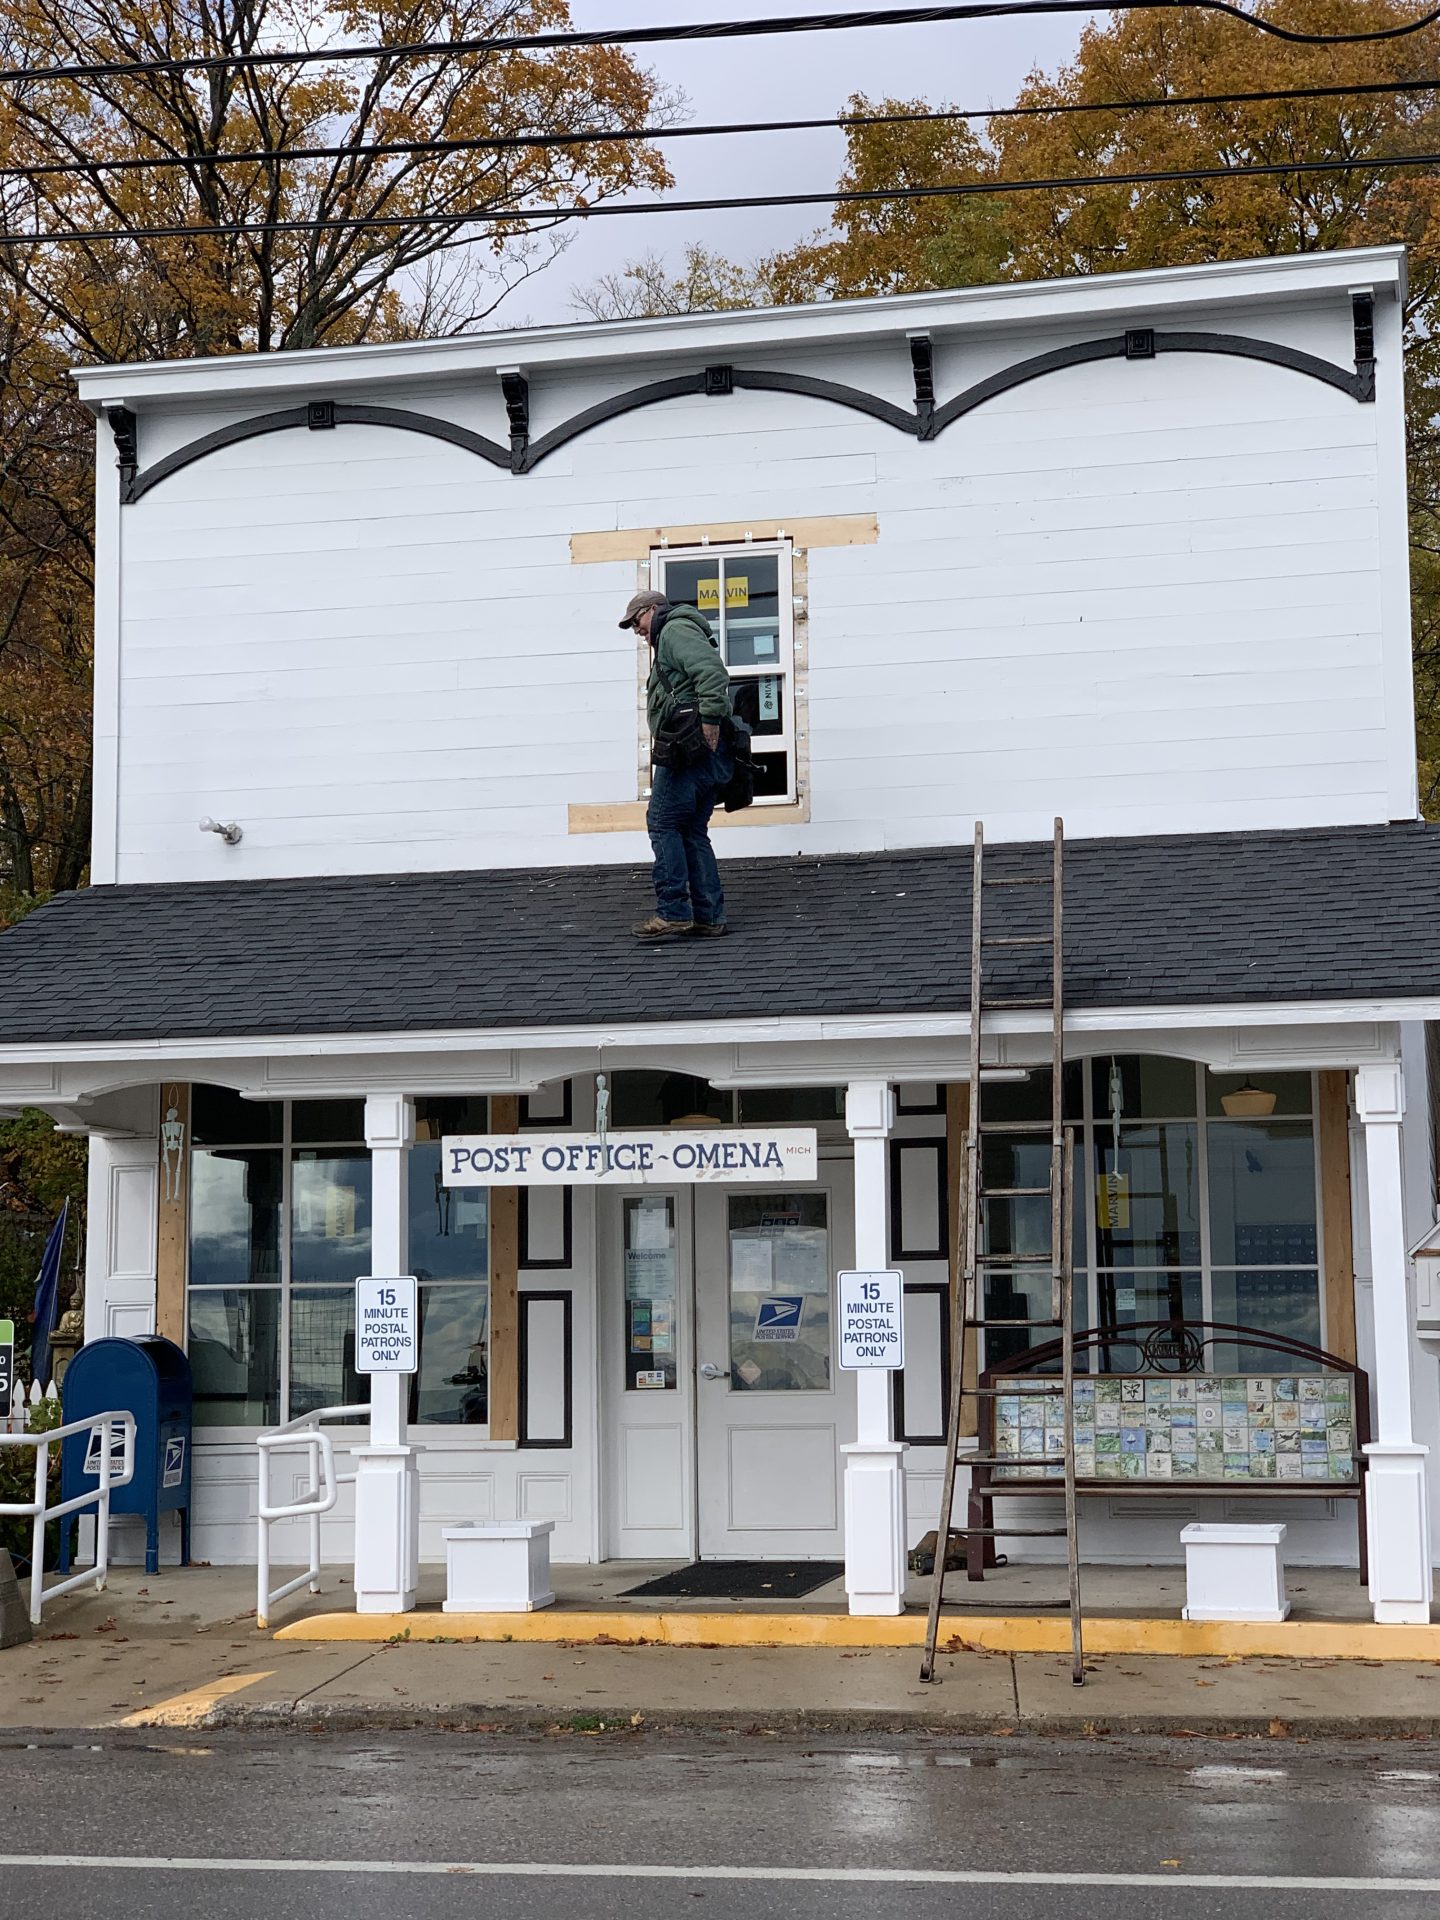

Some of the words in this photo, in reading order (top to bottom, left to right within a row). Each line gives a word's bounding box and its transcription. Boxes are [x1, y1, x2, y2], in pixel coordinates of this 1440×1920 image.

[699, 587, 747, 600] MAVIN
[450, 1147, 531, 1173] POST
[542, 1144, 654, 1171] OFFICE
[672, 1142, 784, 1169] OMENA
[786, 1146, 811, 1154] MICH
[1108, 1175, 1119, 1227] MARVIN
[628, 1251, 666, 1260] Welcome
[377, 1288, 396, 1305] 15
[860, 1282, 881, 1300] 15
[364, 1308, 408, 1318] MINUTE
[847, 1302, 894, 1313] MINUTE
[365, 1323, 408, 1334] POSTAL
[848, 1318, 893, 1329] POSTAL
[361, 1336, 412, 1347] PATRONS
[844, 1332, 898, 1343] PATRONS
[372, 1350, 400, 1360] ONLY
[856, 1346, 886, 1357] ONLY
